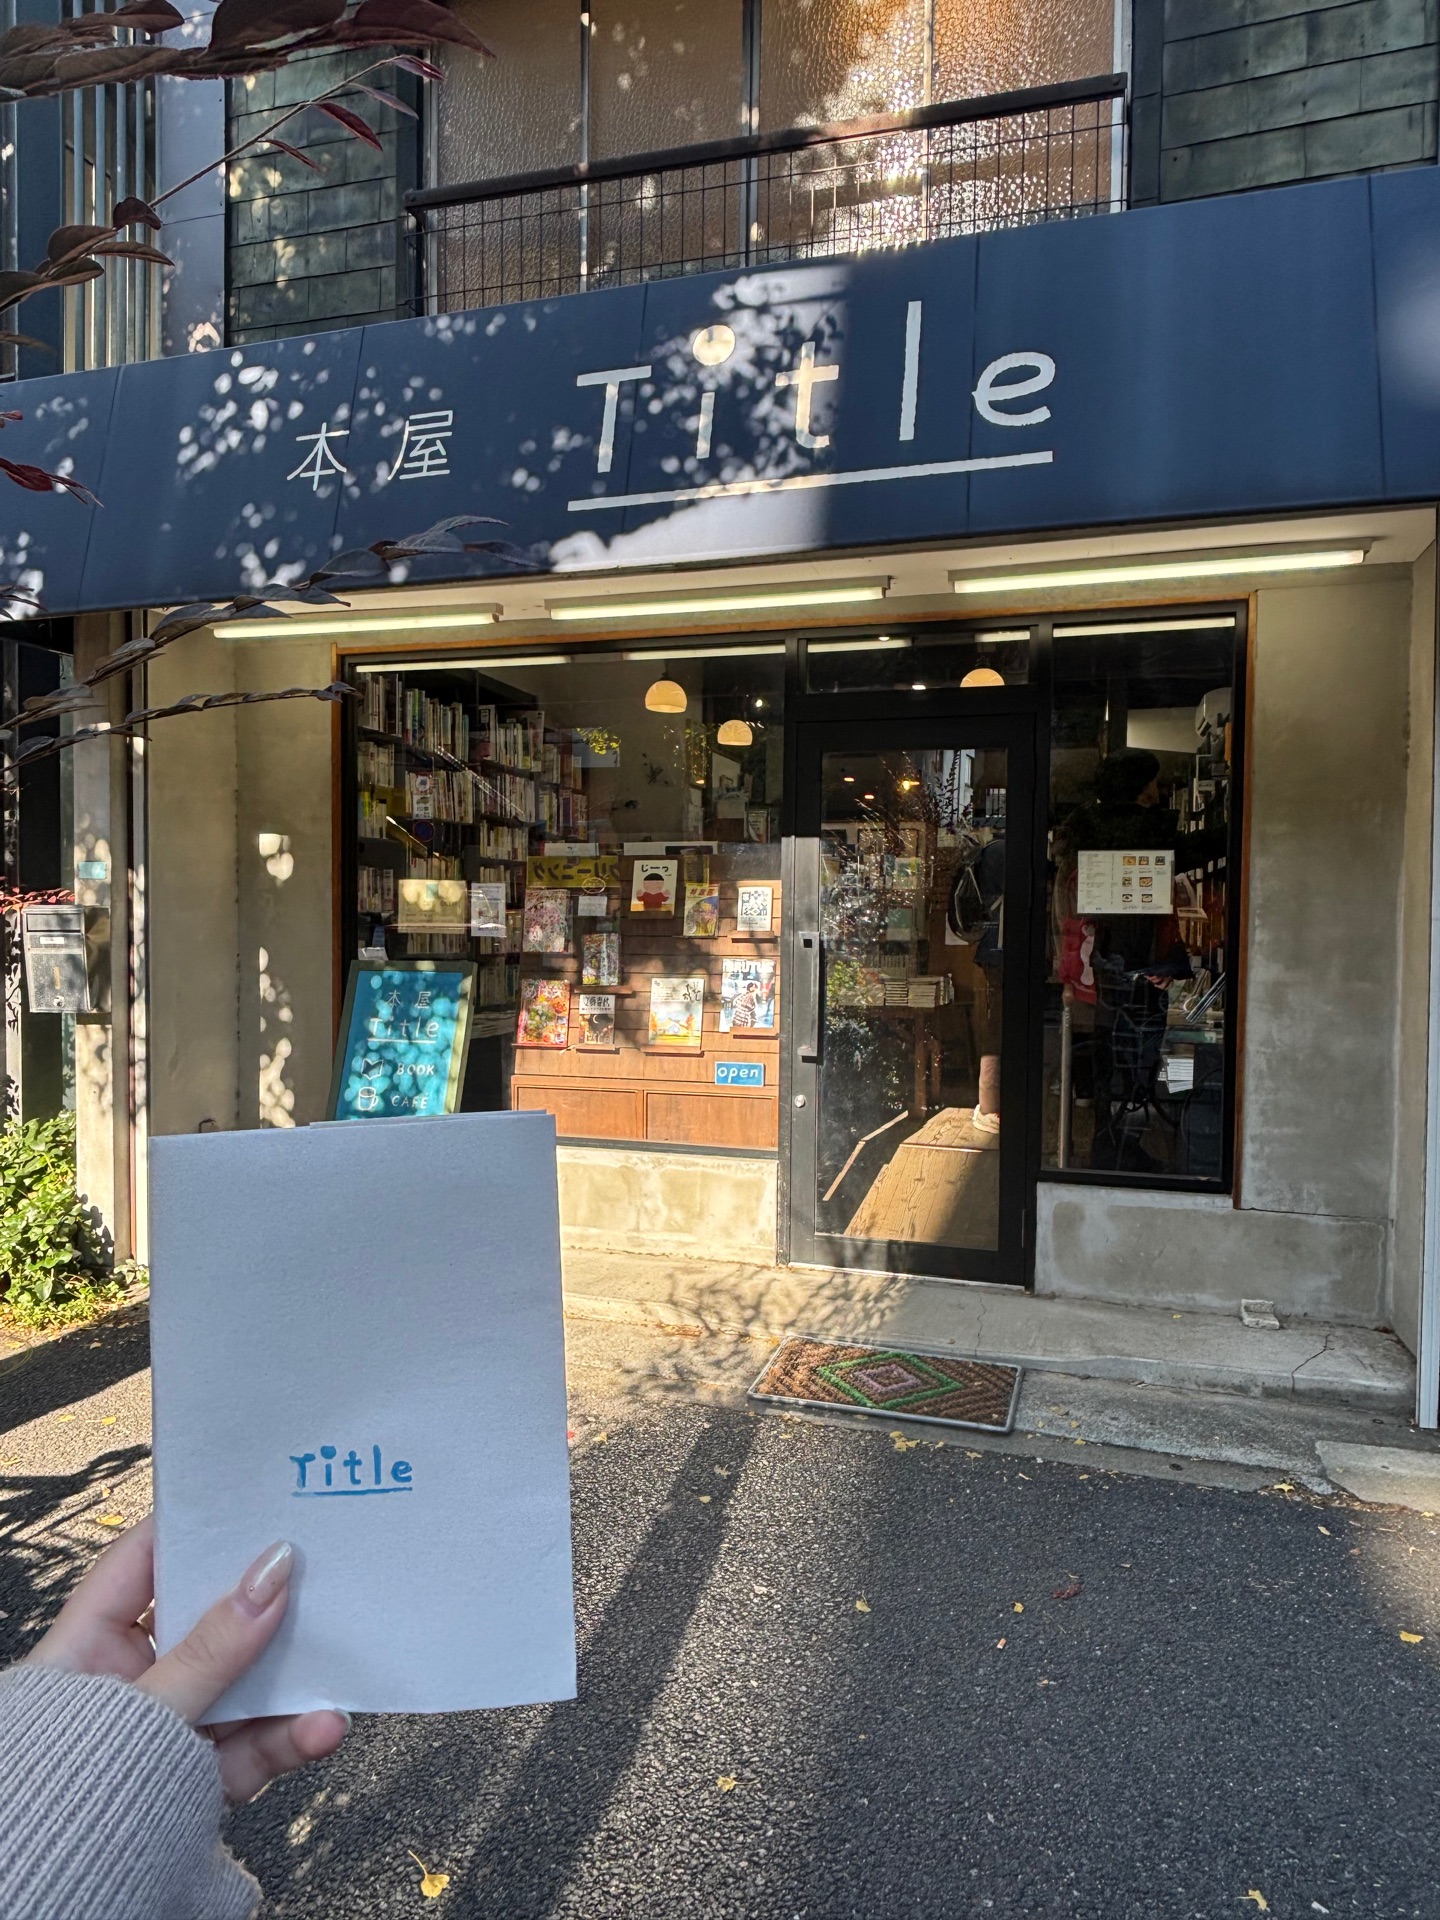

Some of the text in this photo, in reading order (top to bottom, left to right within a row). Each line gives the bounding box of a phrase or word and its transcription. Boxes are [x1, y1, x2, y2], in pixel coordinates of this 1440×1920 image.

[576, 300, 1057, 474] Title
[286, 410, 454, 492] 本屋
[384, 990, 431, 1010] 本屋
[369, 1016, 439, 1038] Title
[396, 1063, 435, 1076] BOOK
[717, 1067, 759, 1084] open
[289, 1444, 413, 1488] Title
